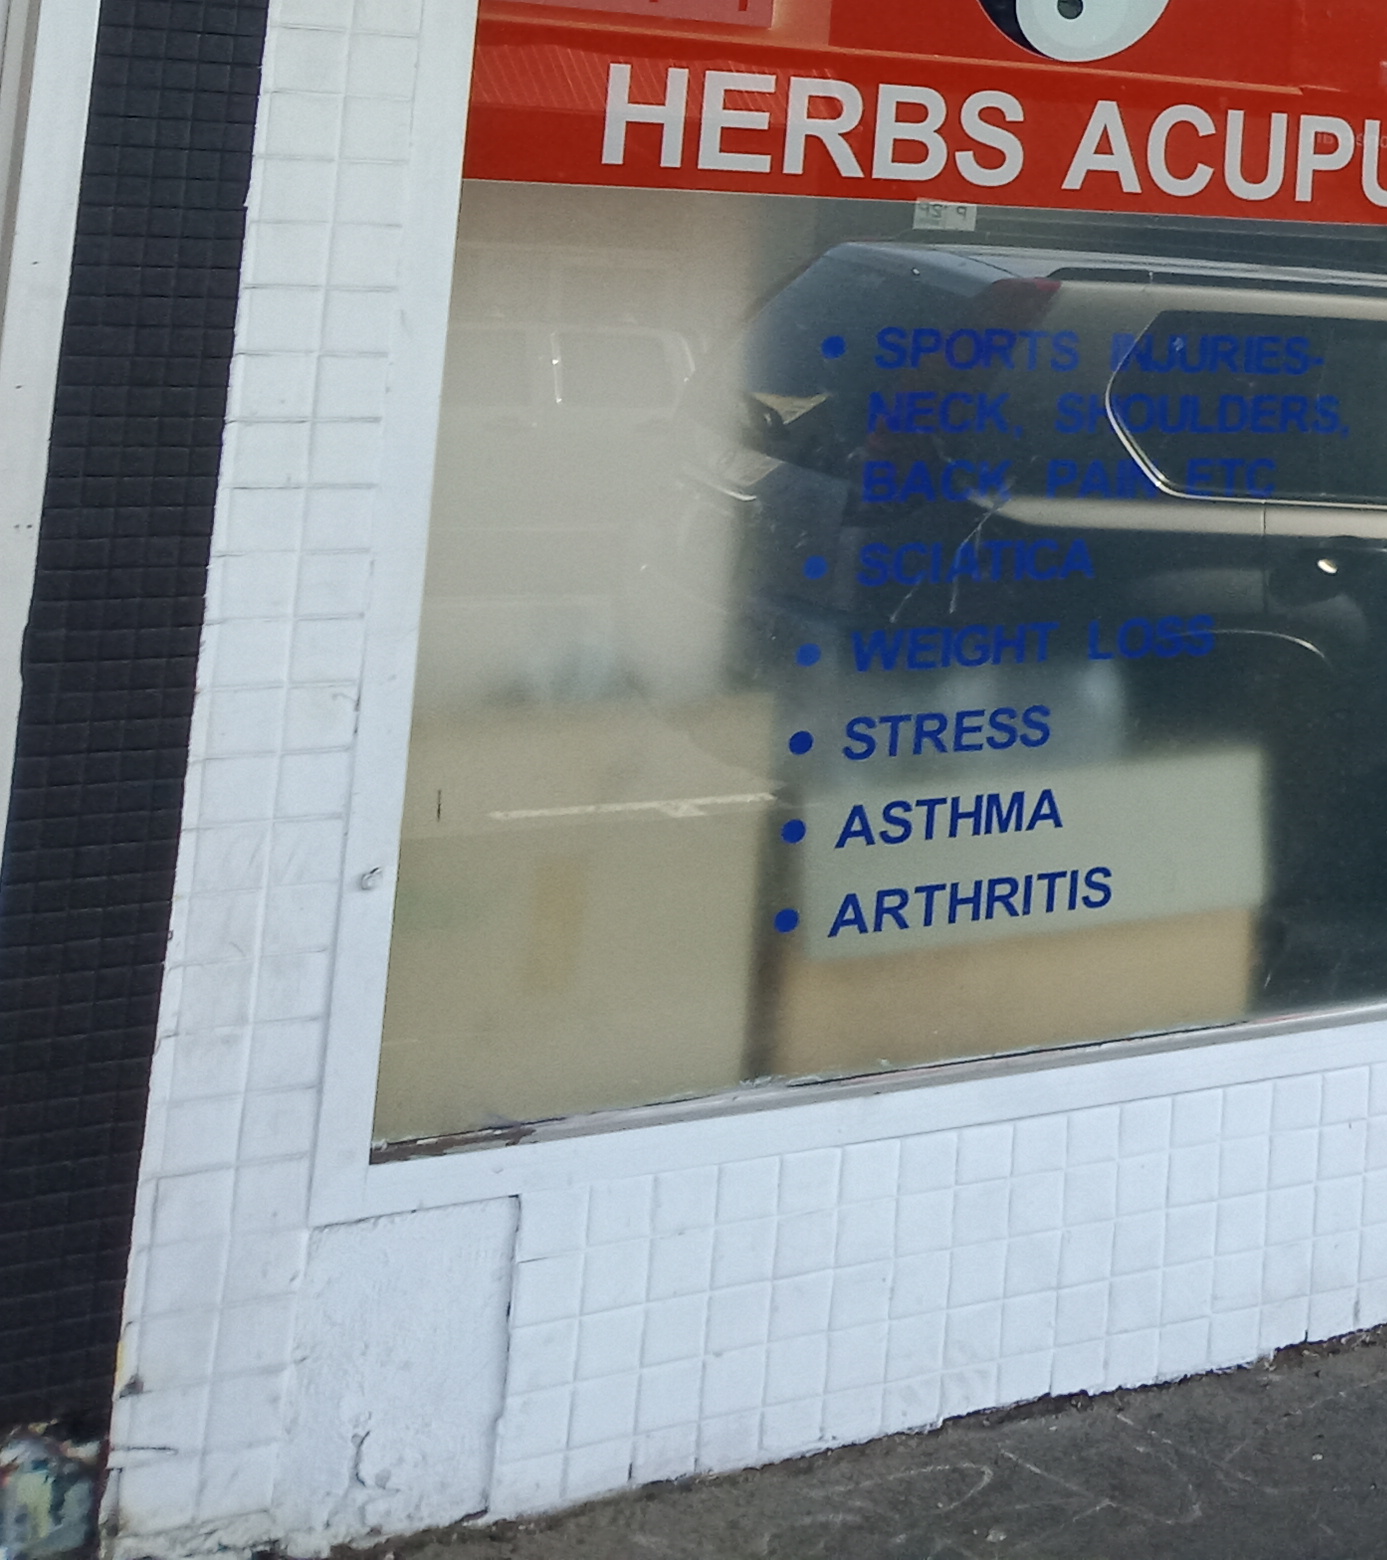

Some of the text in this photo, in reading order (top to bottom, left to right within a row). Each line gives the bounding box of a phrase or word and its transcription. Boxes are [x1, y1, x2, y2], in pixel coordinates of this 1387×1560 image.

[601, 63, 1025, 188] HERBS
[873, 326, 1080, 373] SPORTS
[867, 391, 1351, 440] NECK, SHOULDERS,
[861, 457, 1278, 504] BACK PAIN ETC
[856, 537, 1095, 588] SCIATICA
[850, 613, 1216, 674] WEIGHT LOSS
[841, 704, 1052, 762] STRESS
[834, 787, 1064, 851] ASTHMA
[826, 865, 1114, 940] ARTHRITIS
